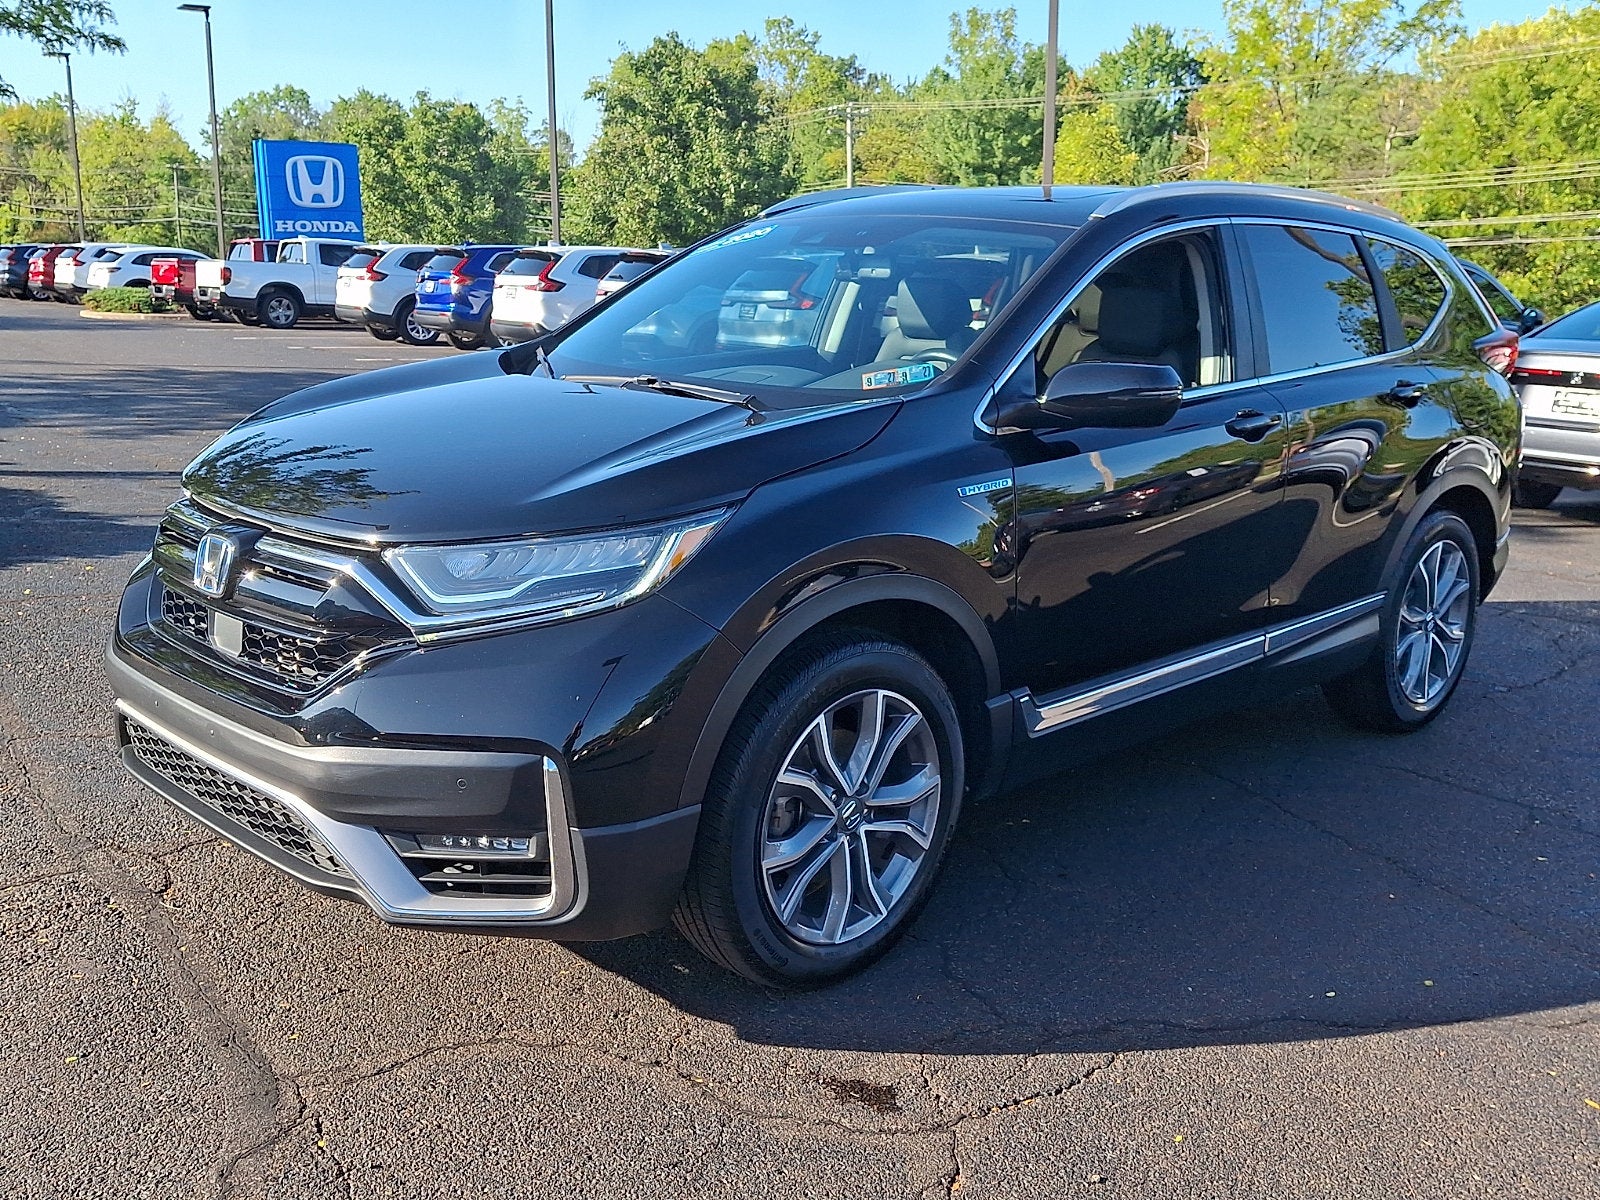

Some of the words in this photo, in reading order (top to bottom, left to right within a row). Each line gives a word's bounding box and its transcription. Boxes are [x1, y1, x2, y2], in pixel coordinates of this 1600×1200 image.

[275, 220, 360, 233] HONDA
[922, 365, 931, 378] 27
[866, 377, 873, 387] 9
[887, 371, 896, 383] 27
[967, 480, 1009, 494] HYBRID
